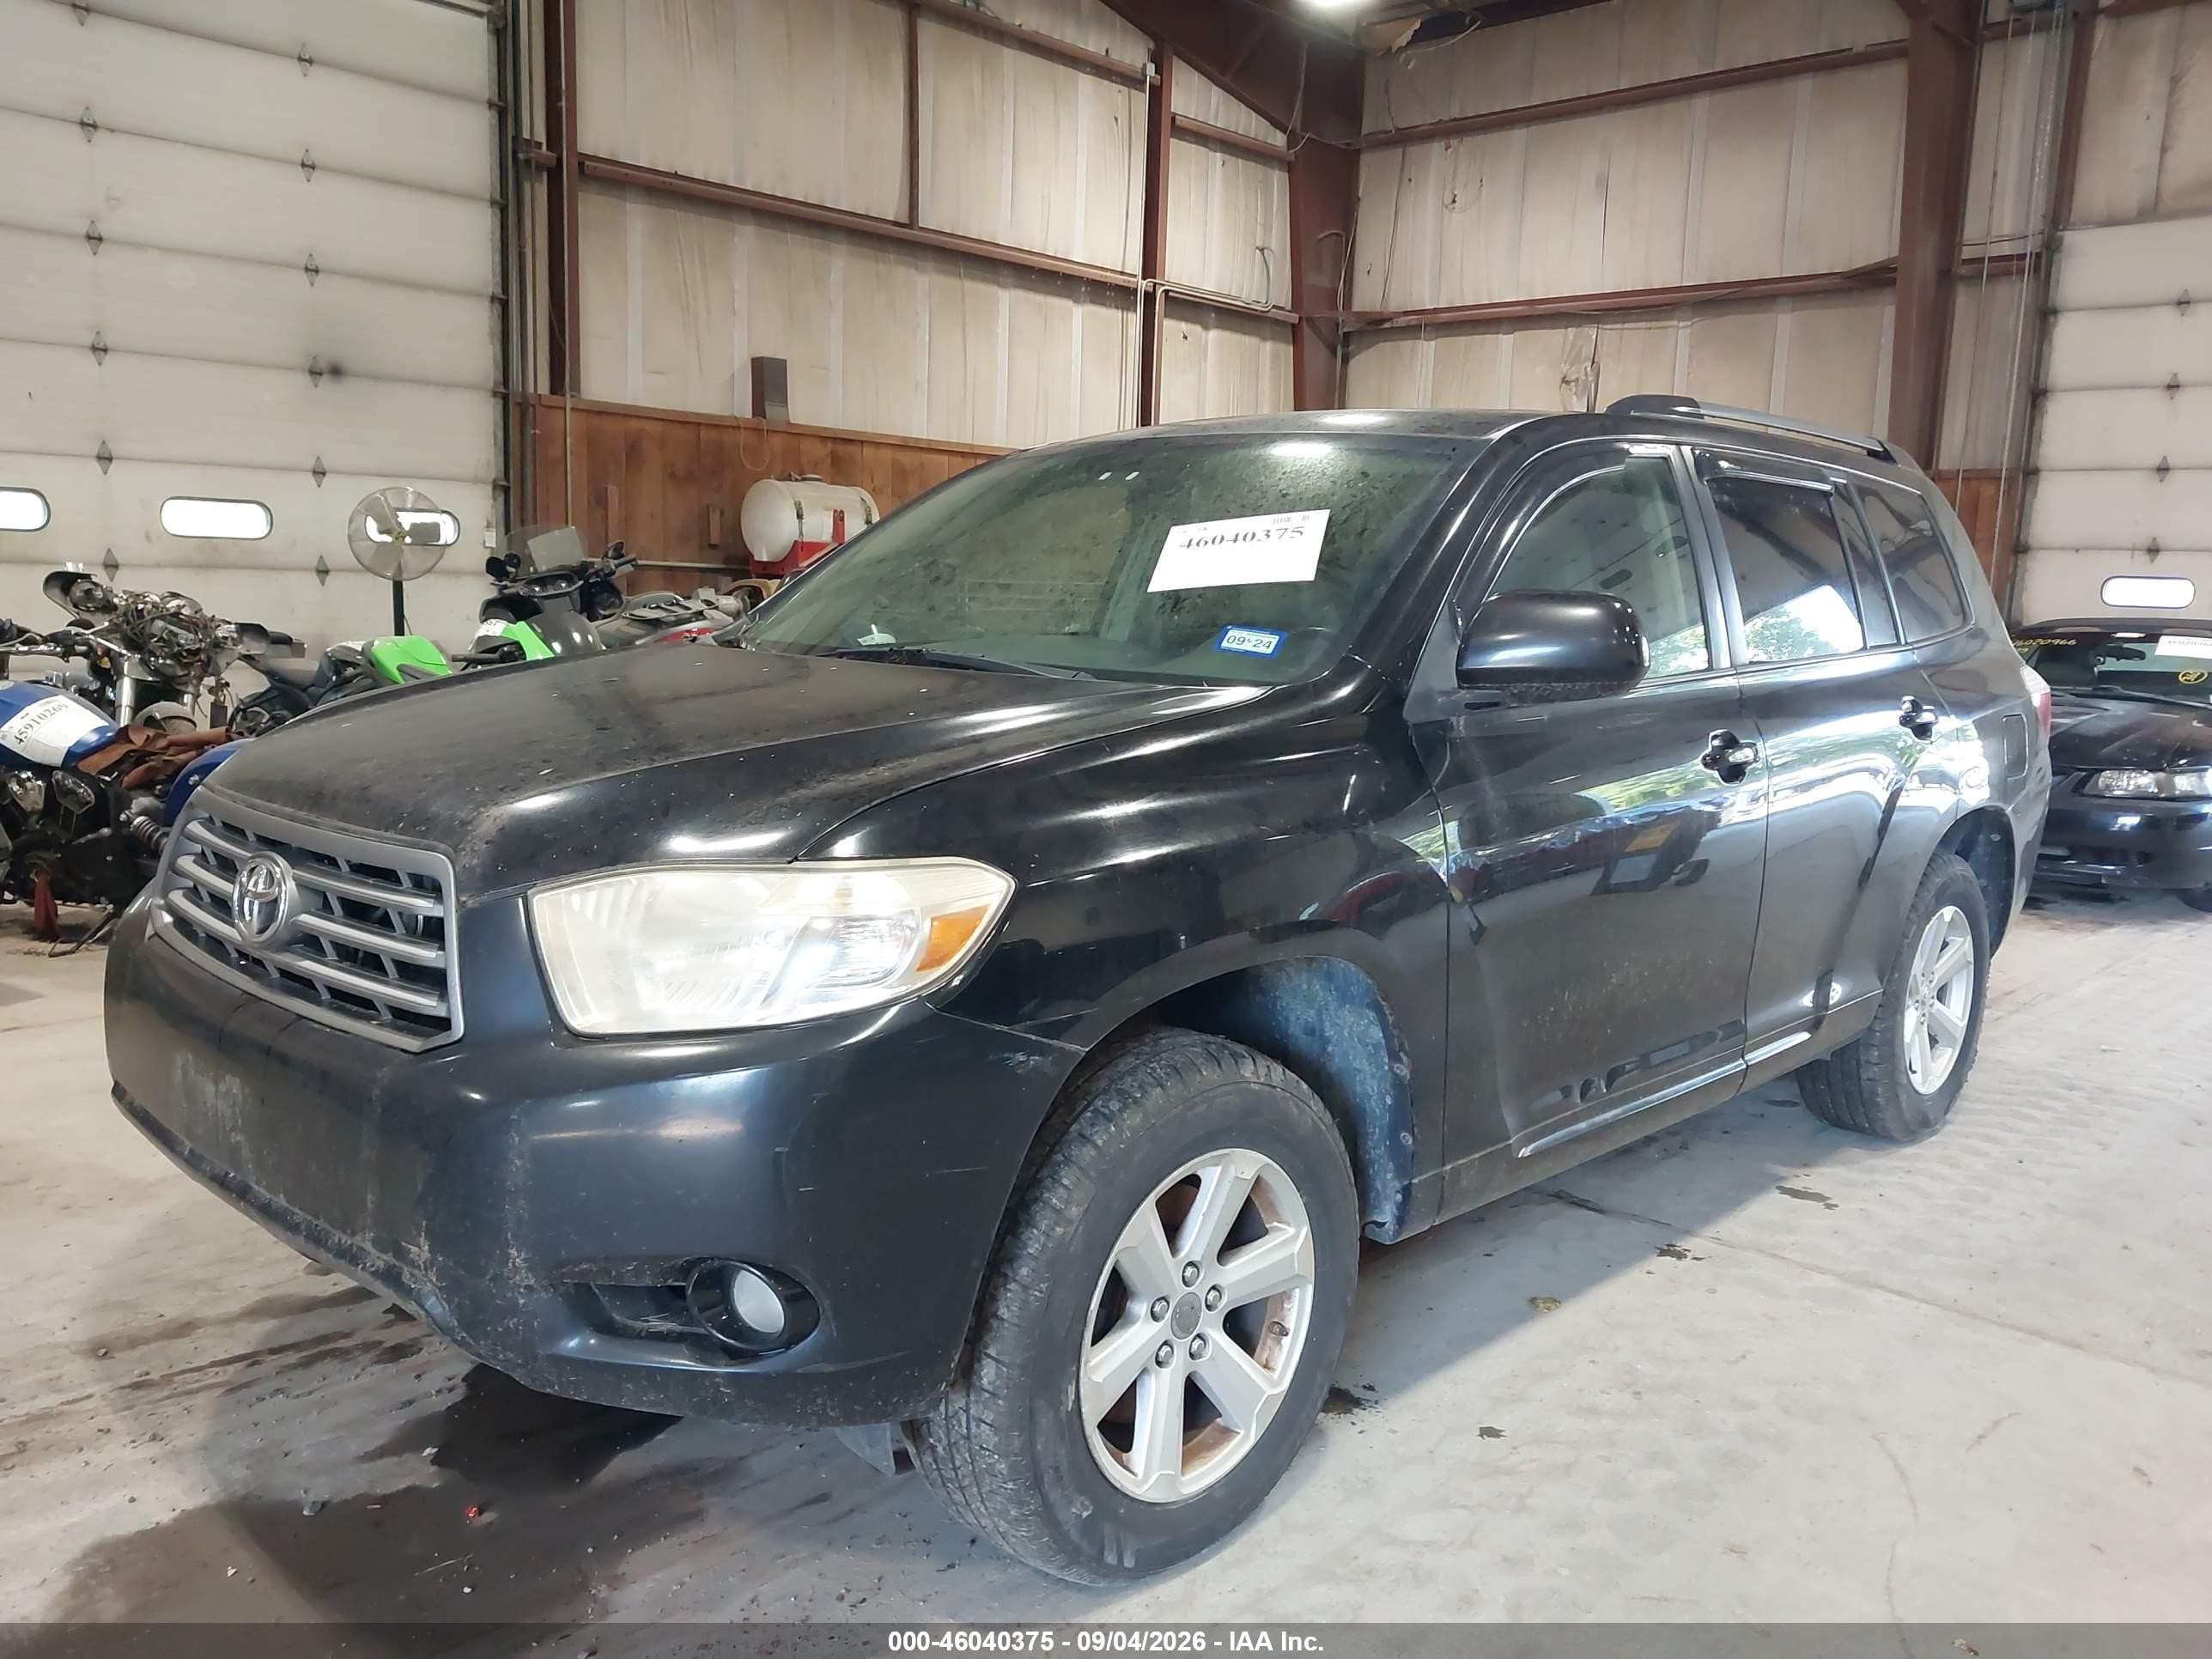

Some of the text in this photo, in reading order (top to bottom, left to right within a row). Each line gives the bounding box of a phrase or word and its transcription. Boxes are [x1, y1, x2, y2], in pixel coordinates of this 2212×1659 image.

[1179, 526, 1305, 549] 46040375
[1226, 635, 1246, 646] 09
[1251, 639, 1273, 650] 24
